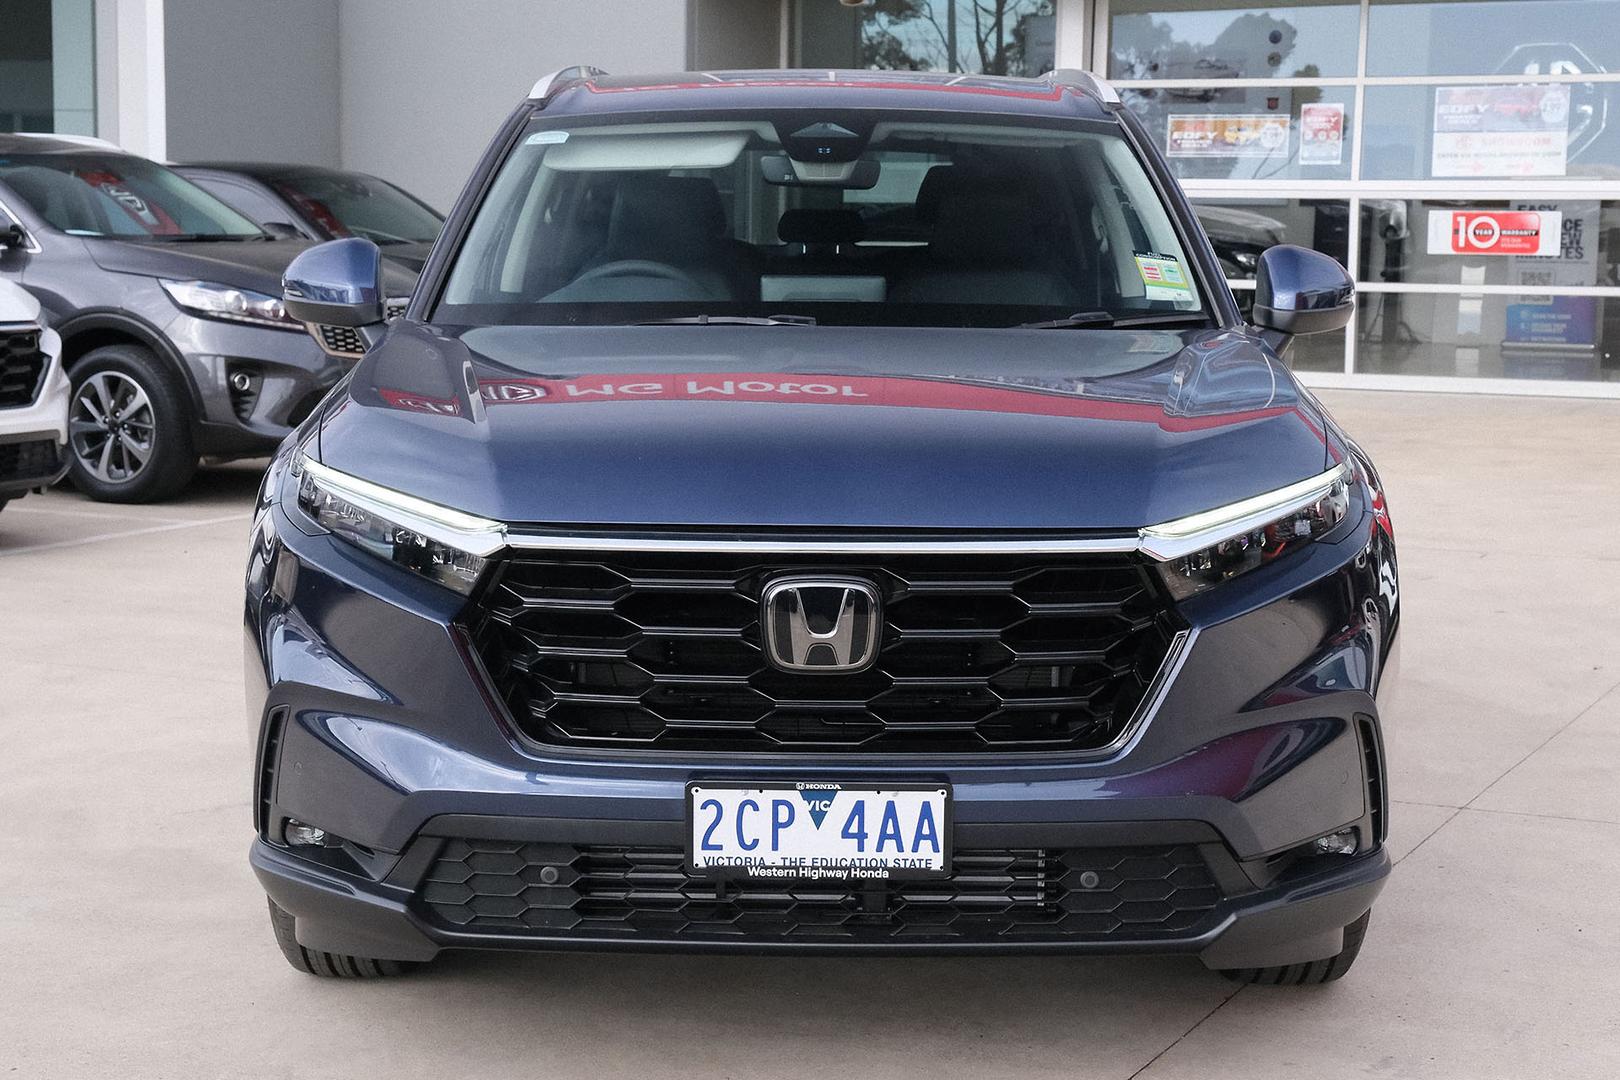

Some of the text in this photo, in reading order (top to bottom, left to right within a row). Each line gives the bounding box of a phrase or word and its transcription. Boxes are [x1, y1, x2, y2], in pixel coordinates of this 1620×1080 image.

[1456, 216, 1501, 249] 10
[803, 800, 832, 812] VIC
[700, 799, 941, 853] 2CP 4AA
[703, 856, 767, 867] VICTORIA
[780, 857, 807, 867] THE
[812, 857, 889, 868] EDUCATION
[893, 858, 933, 869] STATE
[747, 866, 889, 880] Western Highway Honda
